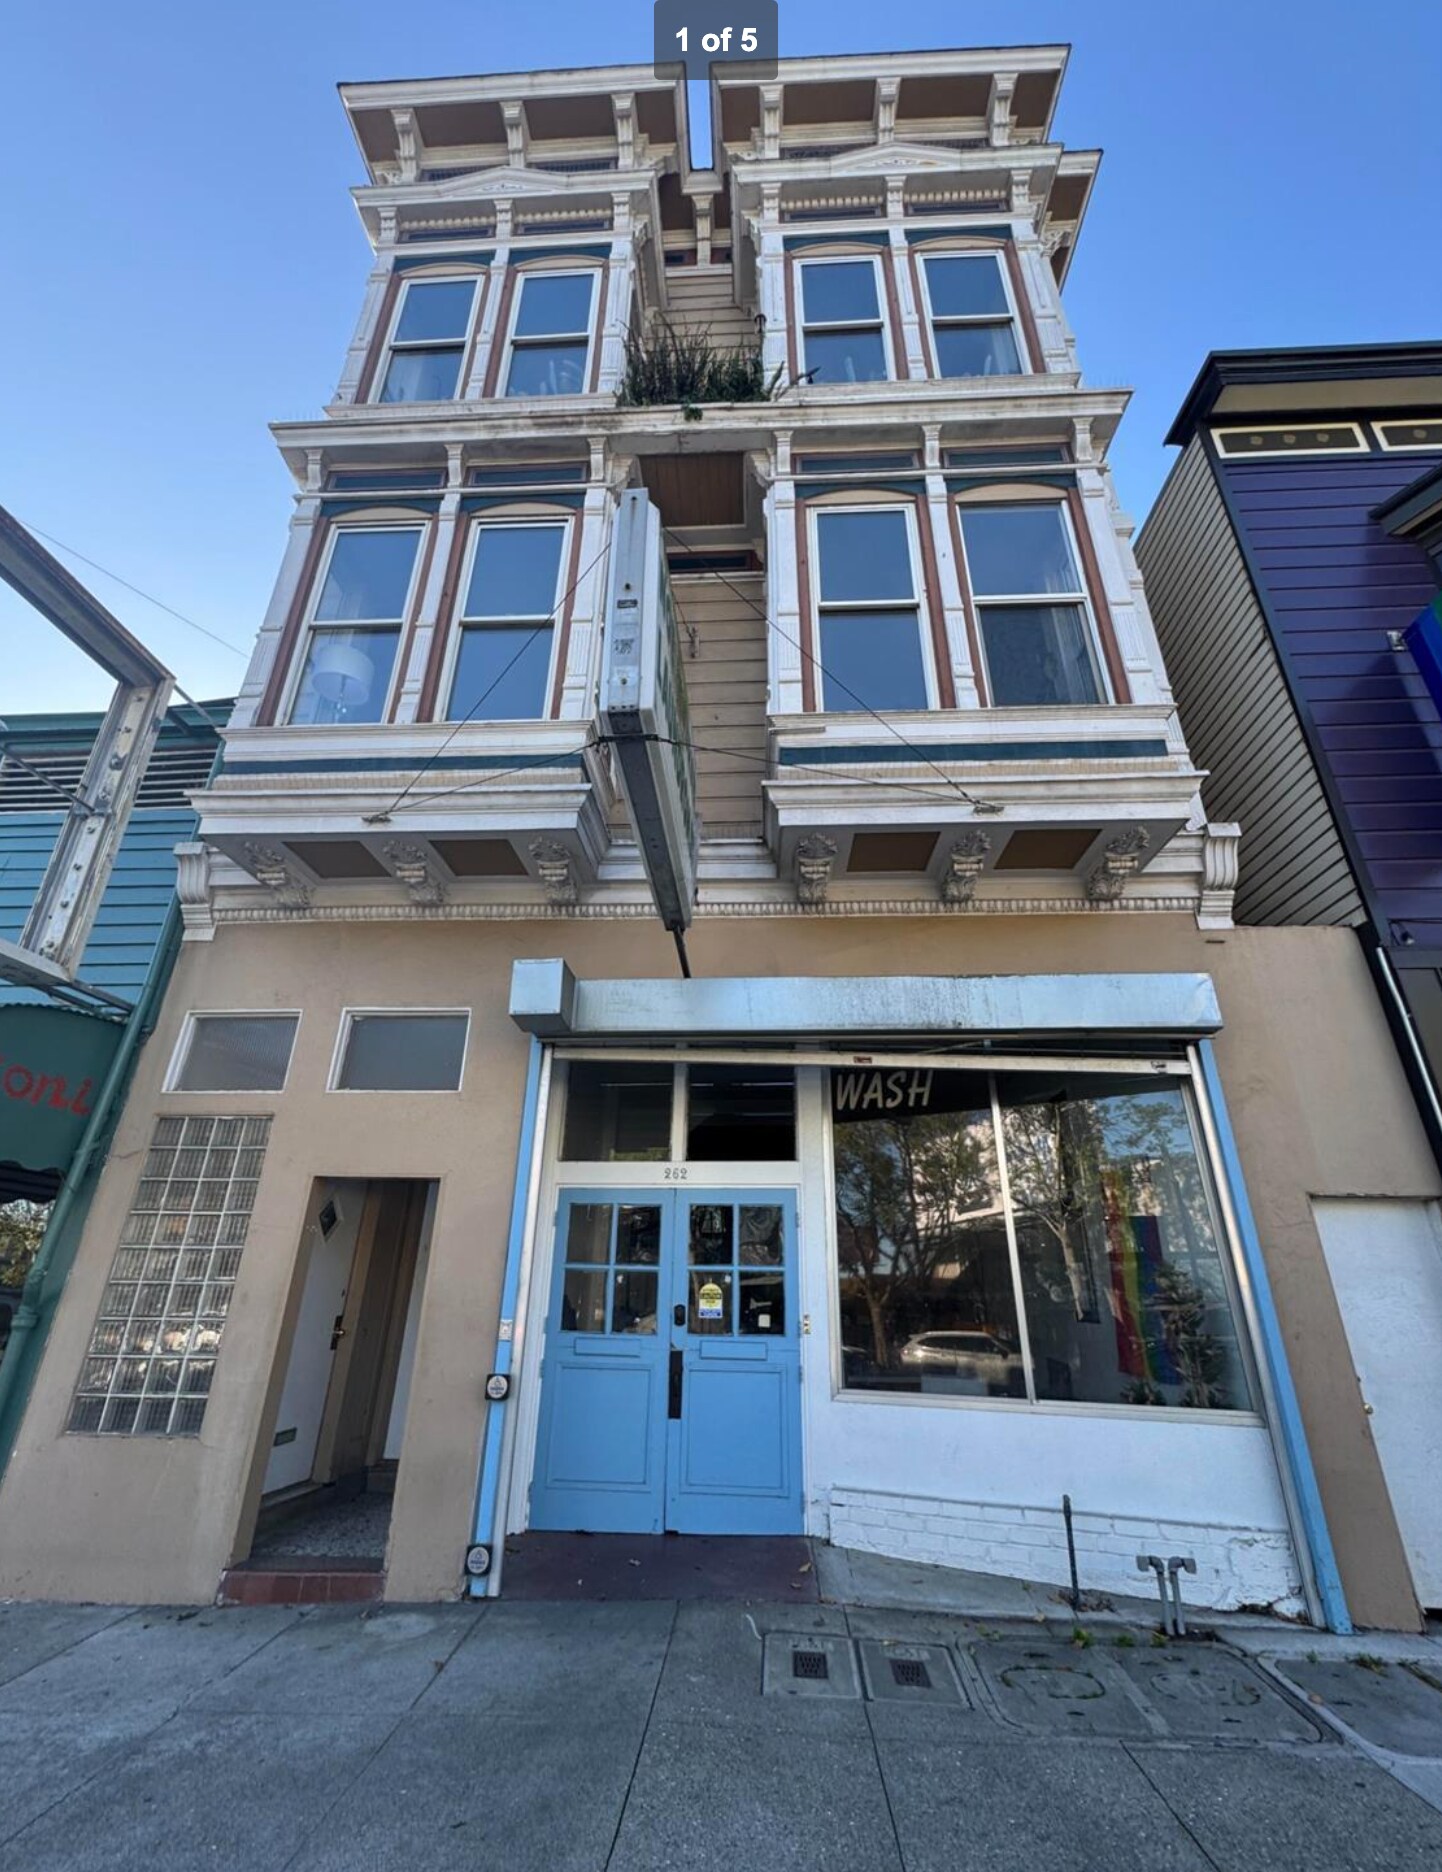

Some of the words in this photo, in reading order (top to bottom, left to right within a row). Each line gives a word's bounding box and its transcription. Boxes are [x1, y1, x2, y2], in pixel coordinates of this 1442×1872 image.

[0, 1055, 92, 1116] oni
[836, 1069, 934, 1110] WASH
[664, 1167, 688, 1180] 262
